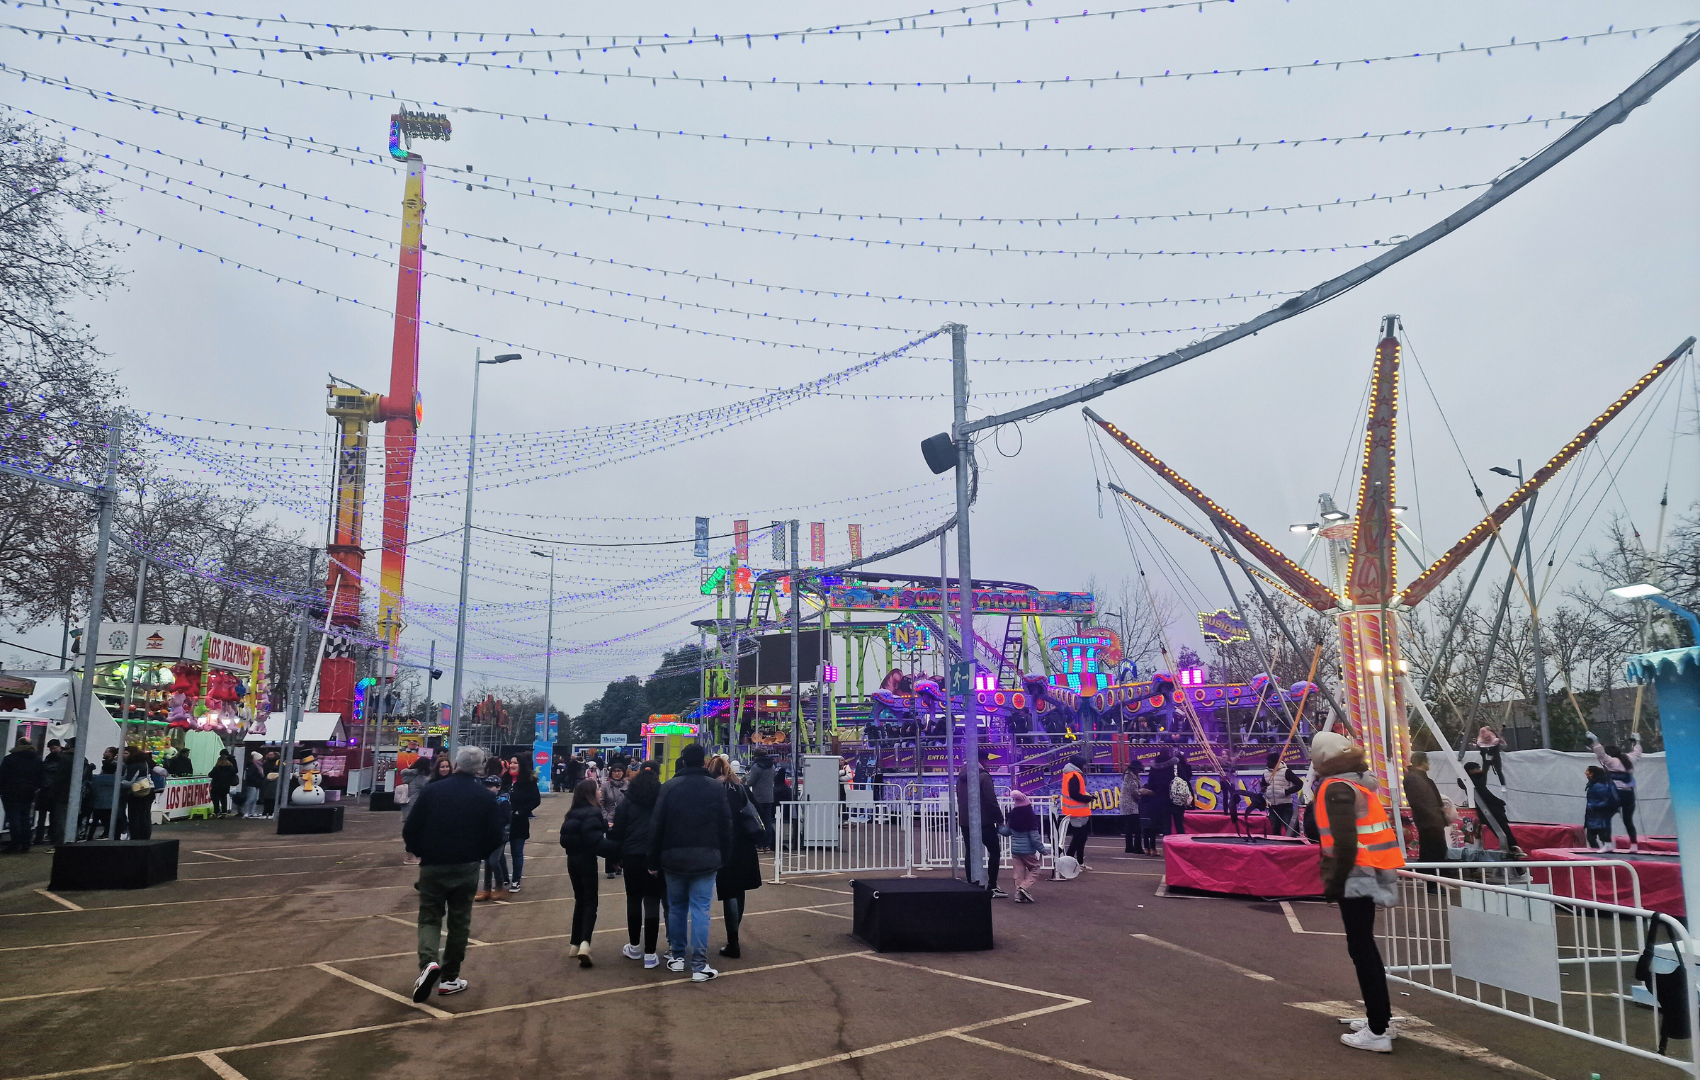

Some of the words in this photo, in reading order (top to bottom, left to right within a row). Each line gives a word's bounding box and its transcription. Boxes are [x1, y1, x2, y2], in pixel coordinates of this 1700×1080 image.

[700, 566, 726, 595] SUPER
[901, 590, 962, 609] SUPR
[208, 636, 221, 660] LOS
[166, 786, 181, 810] LOS
